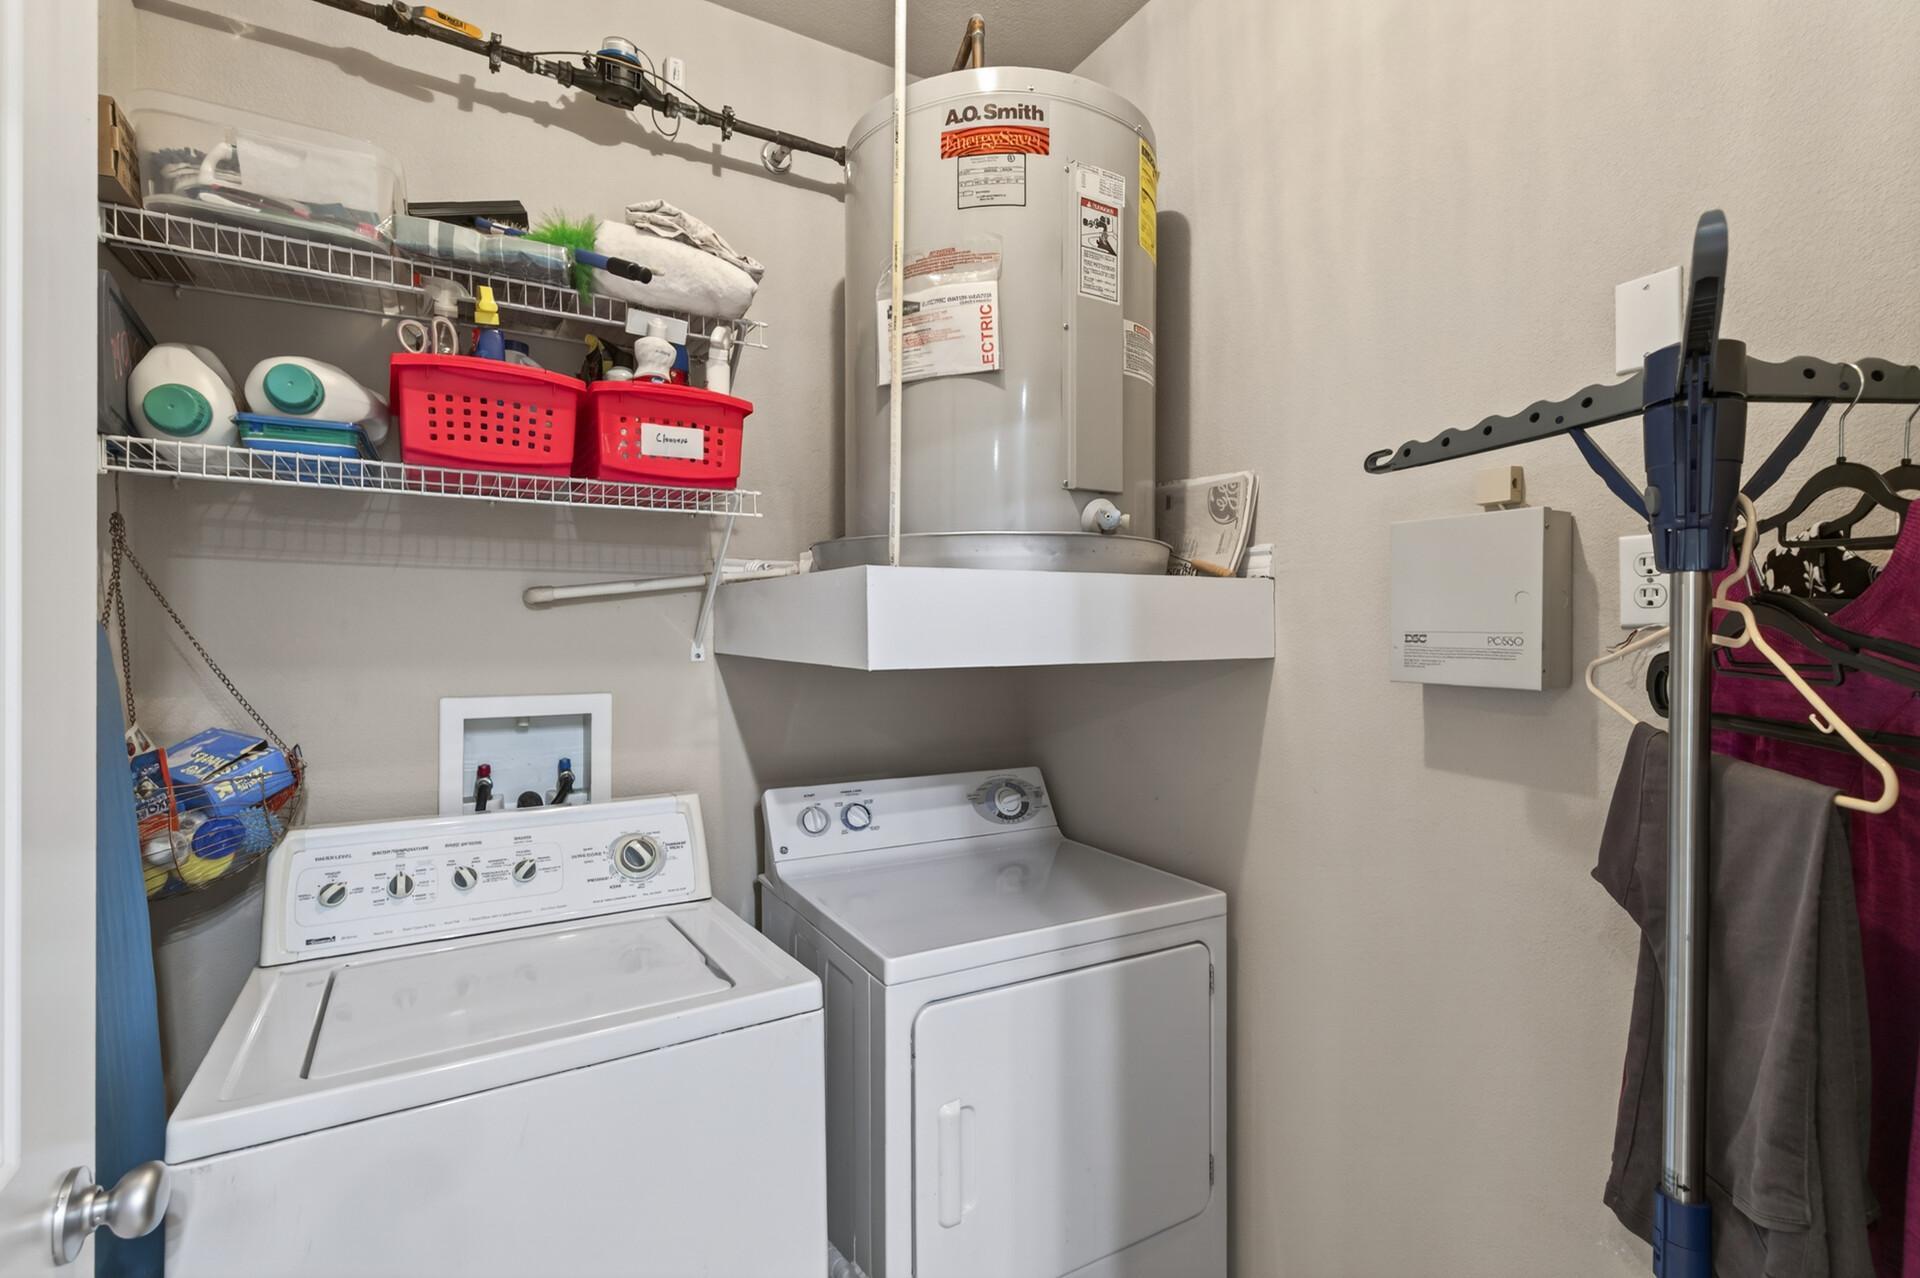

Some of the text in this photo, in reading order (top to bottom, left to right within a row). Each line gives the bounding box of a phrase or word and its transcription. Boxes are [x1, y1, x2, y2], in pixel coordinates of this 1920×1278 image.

[945, 103, 1044, 126] A.O. Smith
[980, 304, 996, 371] ECTRIC
[1404, 633, 1427, 644] DSC
